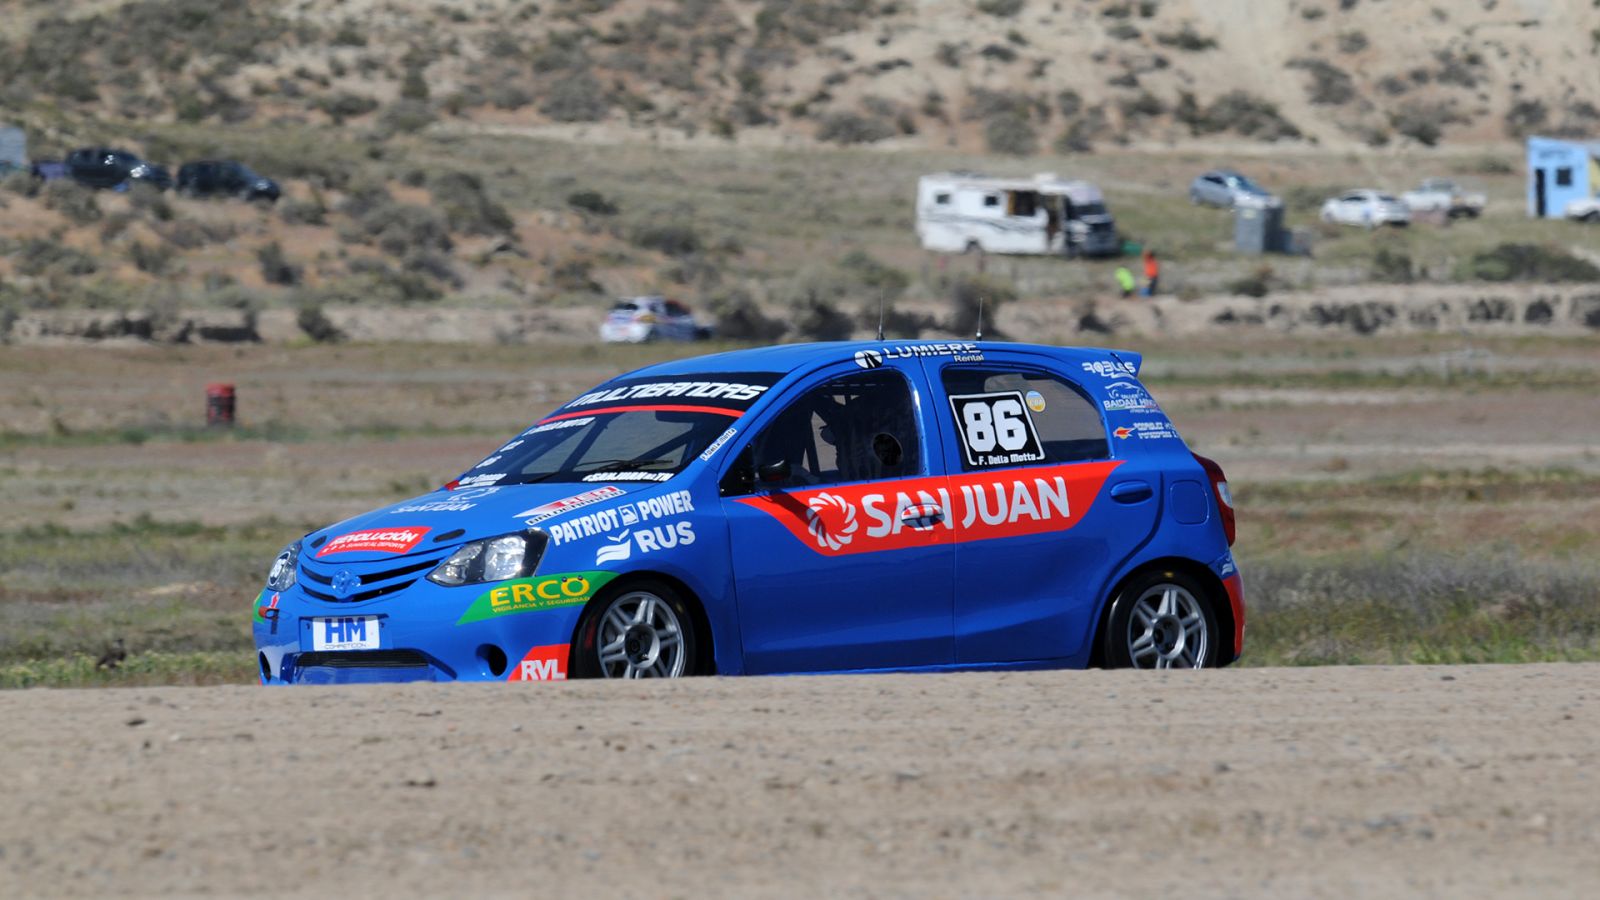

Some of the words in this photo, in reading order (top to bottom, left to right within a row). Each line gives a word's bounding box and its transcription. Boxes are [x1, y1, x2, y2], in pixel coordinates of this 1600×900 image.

[883, 343, 981, 359] LUMIERE
[954, 354, 985, 362] Rental
[565, 382, 769, 409] MULTIBANDAS
[963, 399, 1028, 452] 86
[979, 456, 988, 465] F.
[988, 455, 1009, 465] Della
[1010, 453, 1036, 463] Motta
[549, 509, 620, 546] PATRIOT
[637, 490, 695, 521] POWER
[862, 487, 954, 537] SAN
[961, 477, 1070, 529] JUAN
[633, 521, 696, 553] RUS
[490, 576, 591, 607] ERCO
[492, 602, 537, 613] VIGILANCIA
[325, 617, 366, 643] HM
[521, 659, 565, 680] RVL
